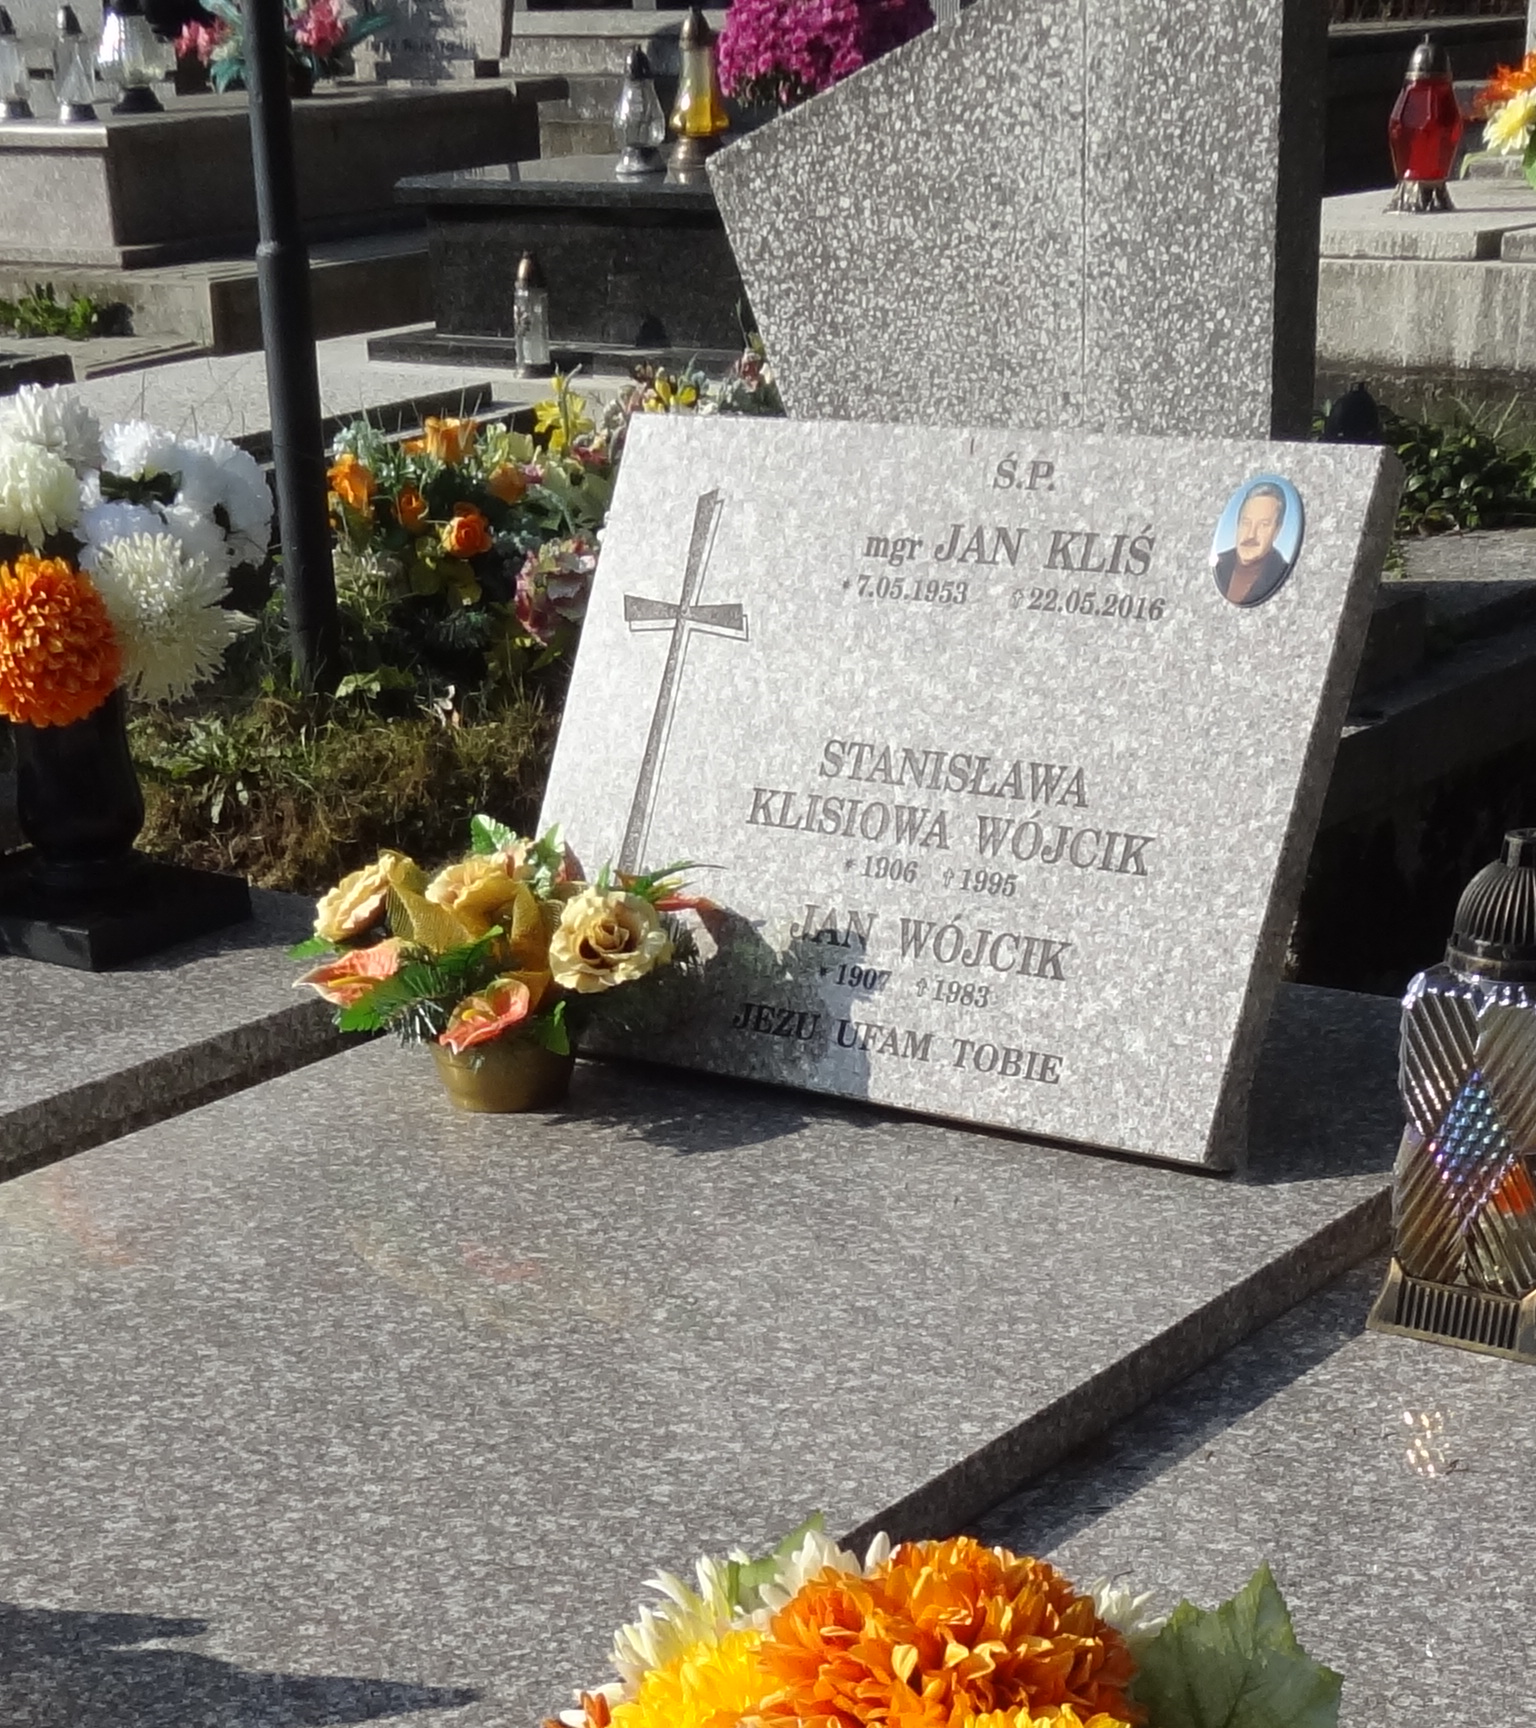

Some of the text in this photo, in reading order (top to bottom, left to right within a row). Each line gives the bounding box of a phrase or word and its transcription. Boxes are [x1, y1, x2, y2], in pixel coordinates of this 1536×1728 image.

[992, 450, 1057, 492] Ś.P.
[863, 523, 1156, 577] mgr JAN KLIŚ
[857, 574, 1167, 622] 7.05.1953 22.05.2016
[818, 739, 1090, 808] STANISŁAWA
[745, 787, 1157, 877] KLISIOWA WÓJCIK
[862, 855, 1019, 898] 1906 1995
[790, 903, 1072, 981] JAN WÓJCIK
[834, 963, 990, 1009] 1907 1983
[835, 1018, 935, 1063] UFAM
[951, 1037, 1064, 1086] TOBIE
